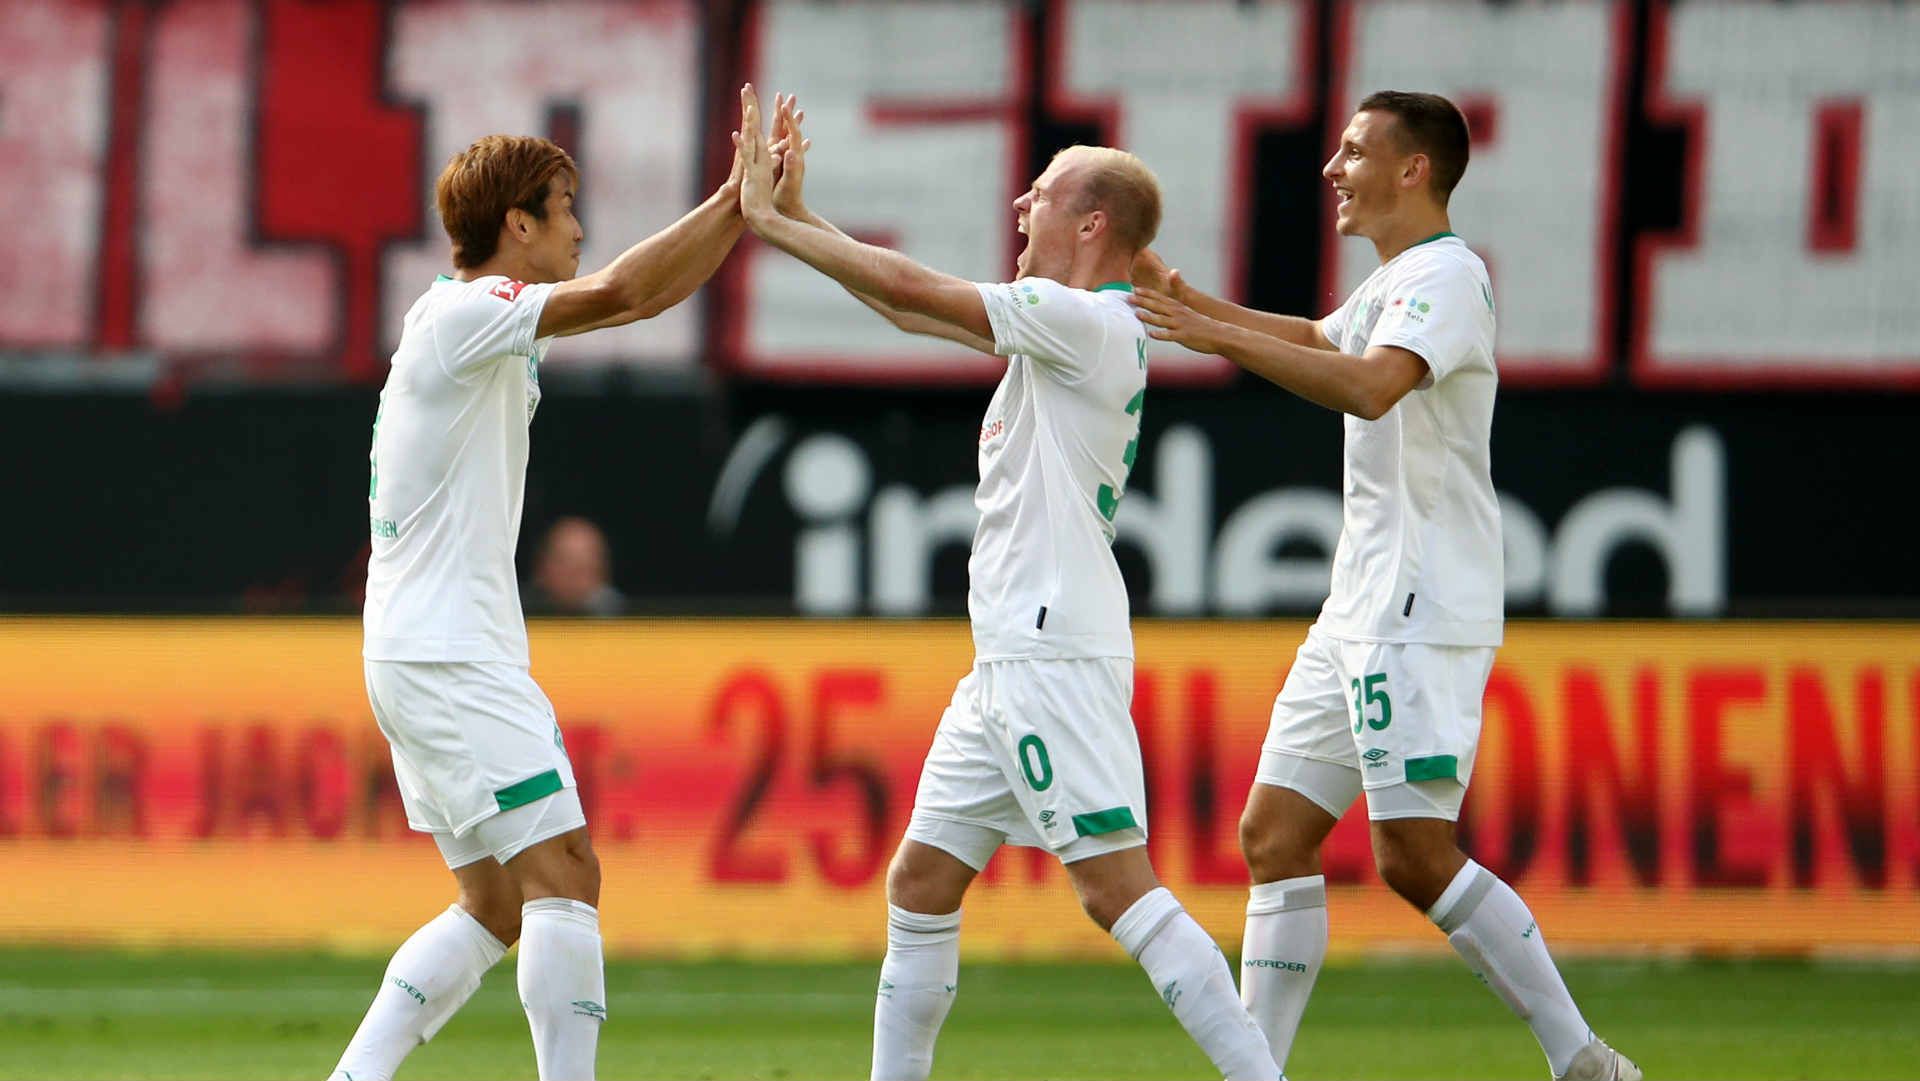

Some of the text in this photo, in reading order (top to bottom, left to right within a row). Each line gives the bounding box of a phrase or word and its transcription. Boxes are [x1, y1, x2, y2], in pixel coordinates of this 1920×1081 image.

[710, 415, 1727, 615] inded
[1352, 672, 1392, 735] 35
[706, 664, 891, 888] 25
[1244, 959, 1307, 973] WERDER
